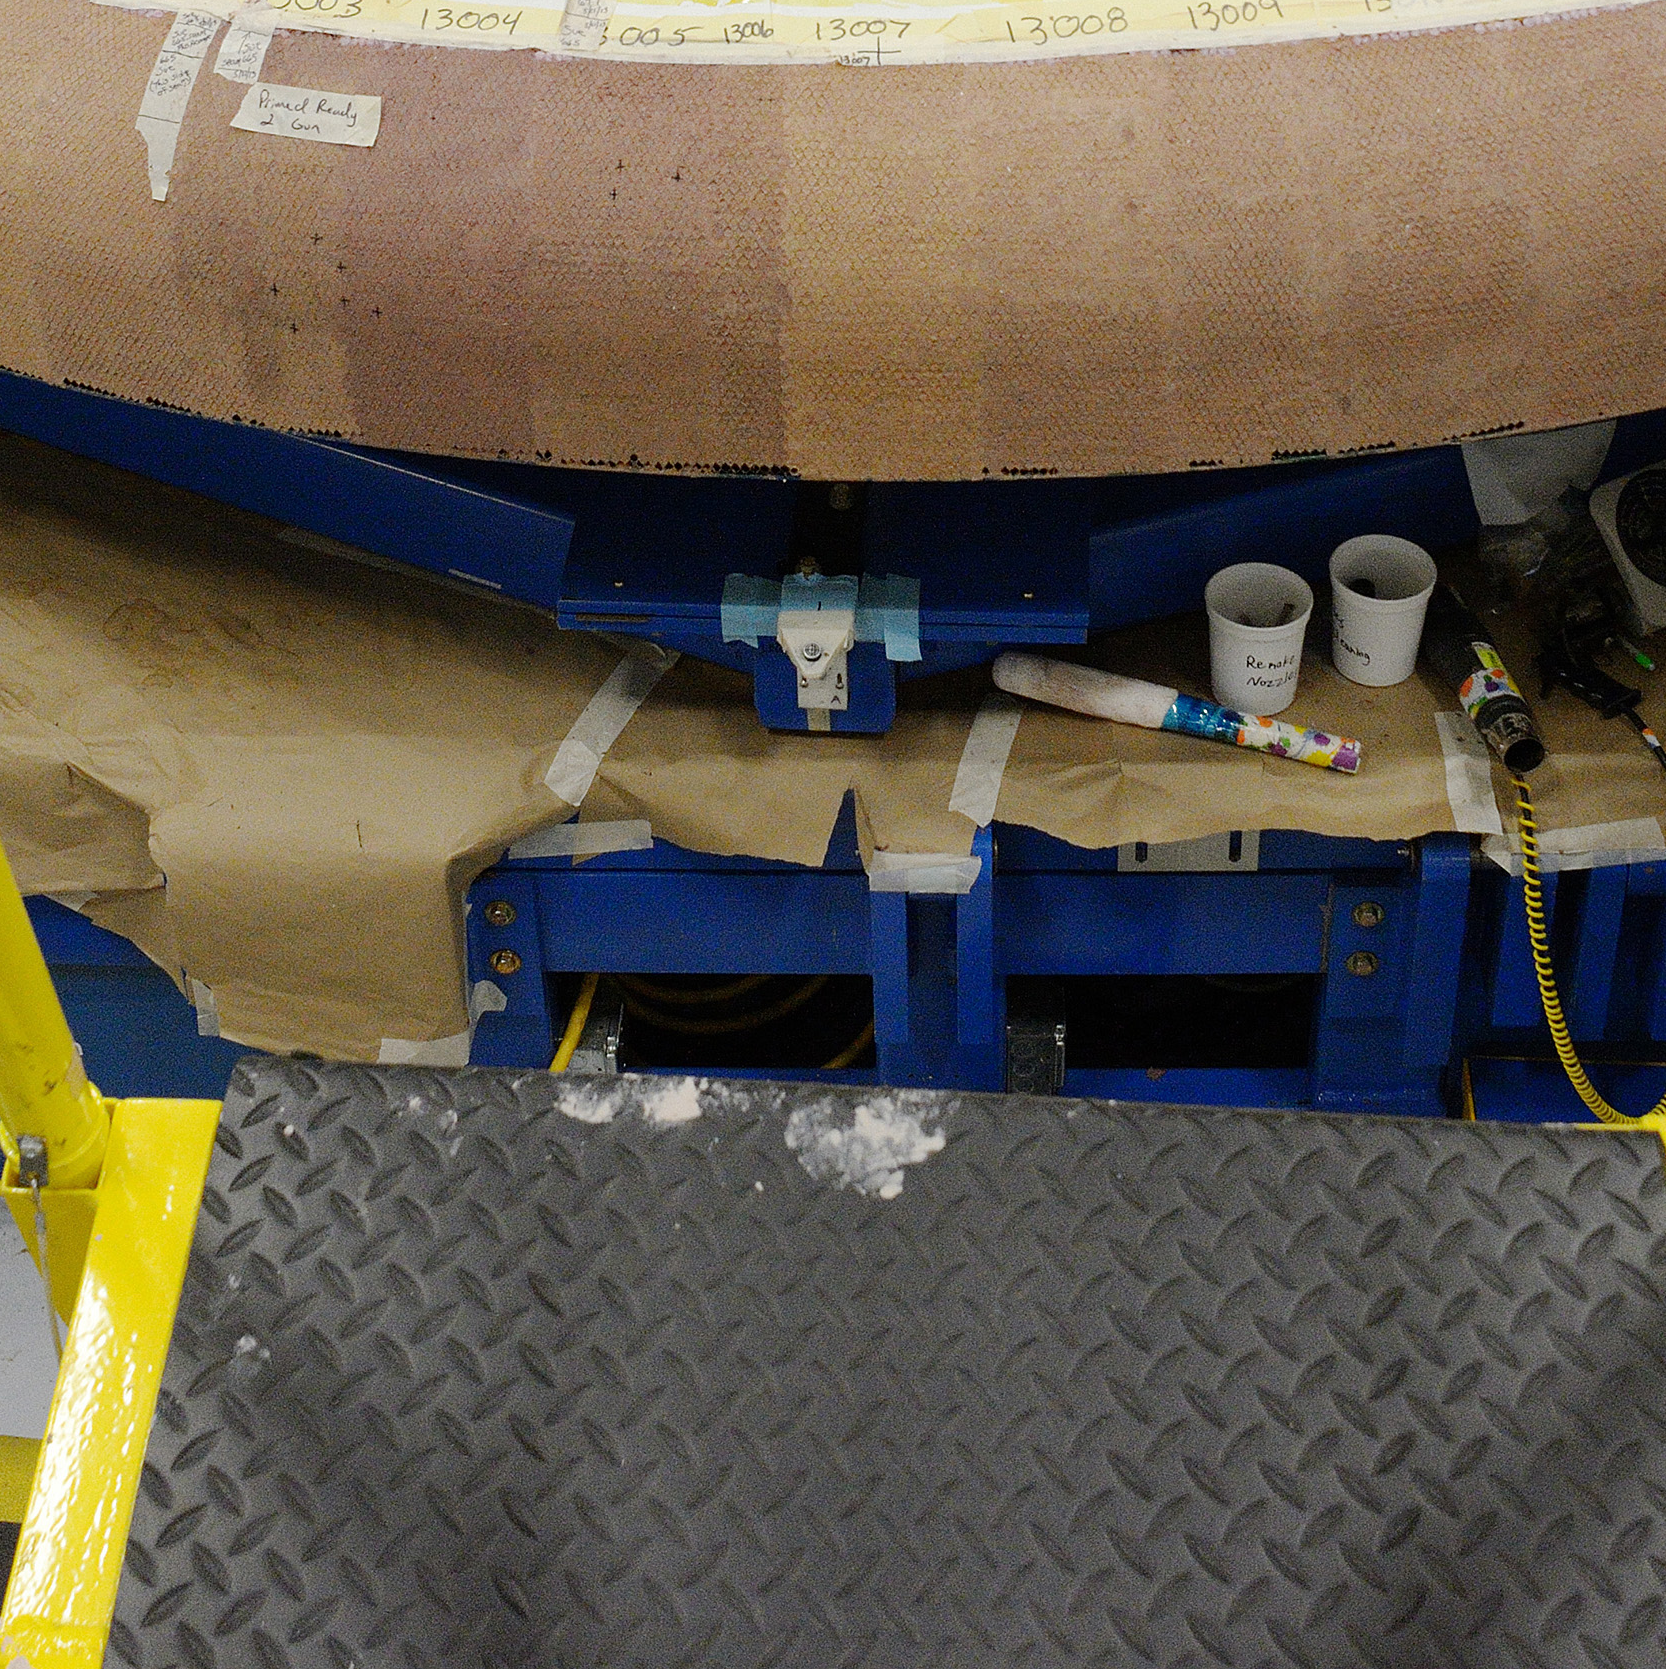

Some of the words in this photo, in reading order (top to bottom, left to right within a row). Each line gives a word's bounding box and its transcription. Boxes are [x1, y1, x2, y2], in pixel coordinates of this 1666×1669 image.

[420, 7, 524, 32] 13004
[815, 19, 912, 41] 13007
[1005, 7, 1129, 46] 13008
[723, 24, 774, 43] 13006
[258, 88, 310, 114] Primed
[315, 98, 358, 128] Ready
[259, 113, 275, 126] 2
[290, 117, 321, 134] Gun
